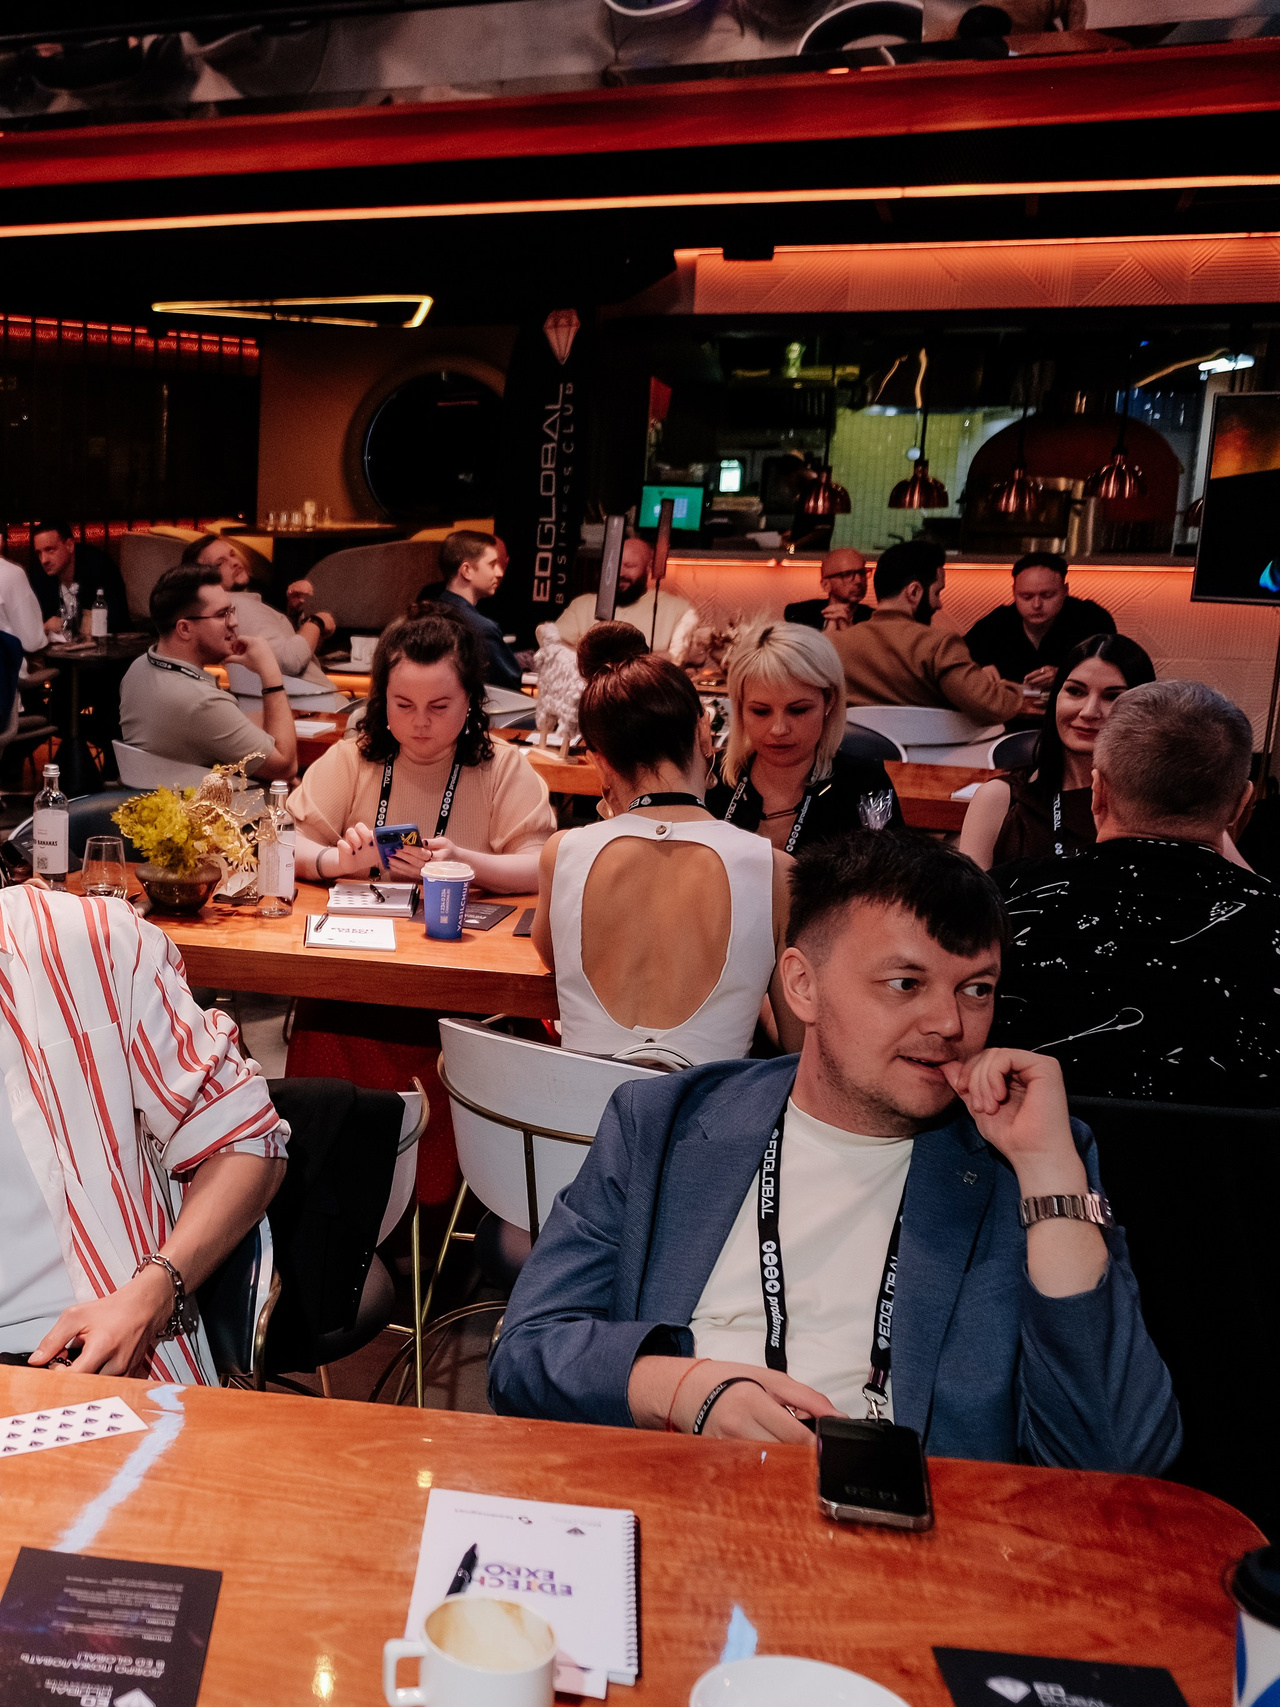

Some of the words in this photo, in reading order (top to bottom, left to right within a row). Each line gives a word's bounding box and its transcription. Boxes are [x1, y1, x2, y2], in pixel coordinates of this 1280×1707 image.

[532, 383, 564, 602] EDGLOBAL
[456, 881, 469, 932] VASILCHUK
[761, 1140, 777, 1219] EDGLOBAL
[766, 1295, 784, 1349] prodamus
[20, 1652, 113, 1674] ПОЖАЛОВАТЬ
[114, 1664, 165, 1679] ДОБРО
